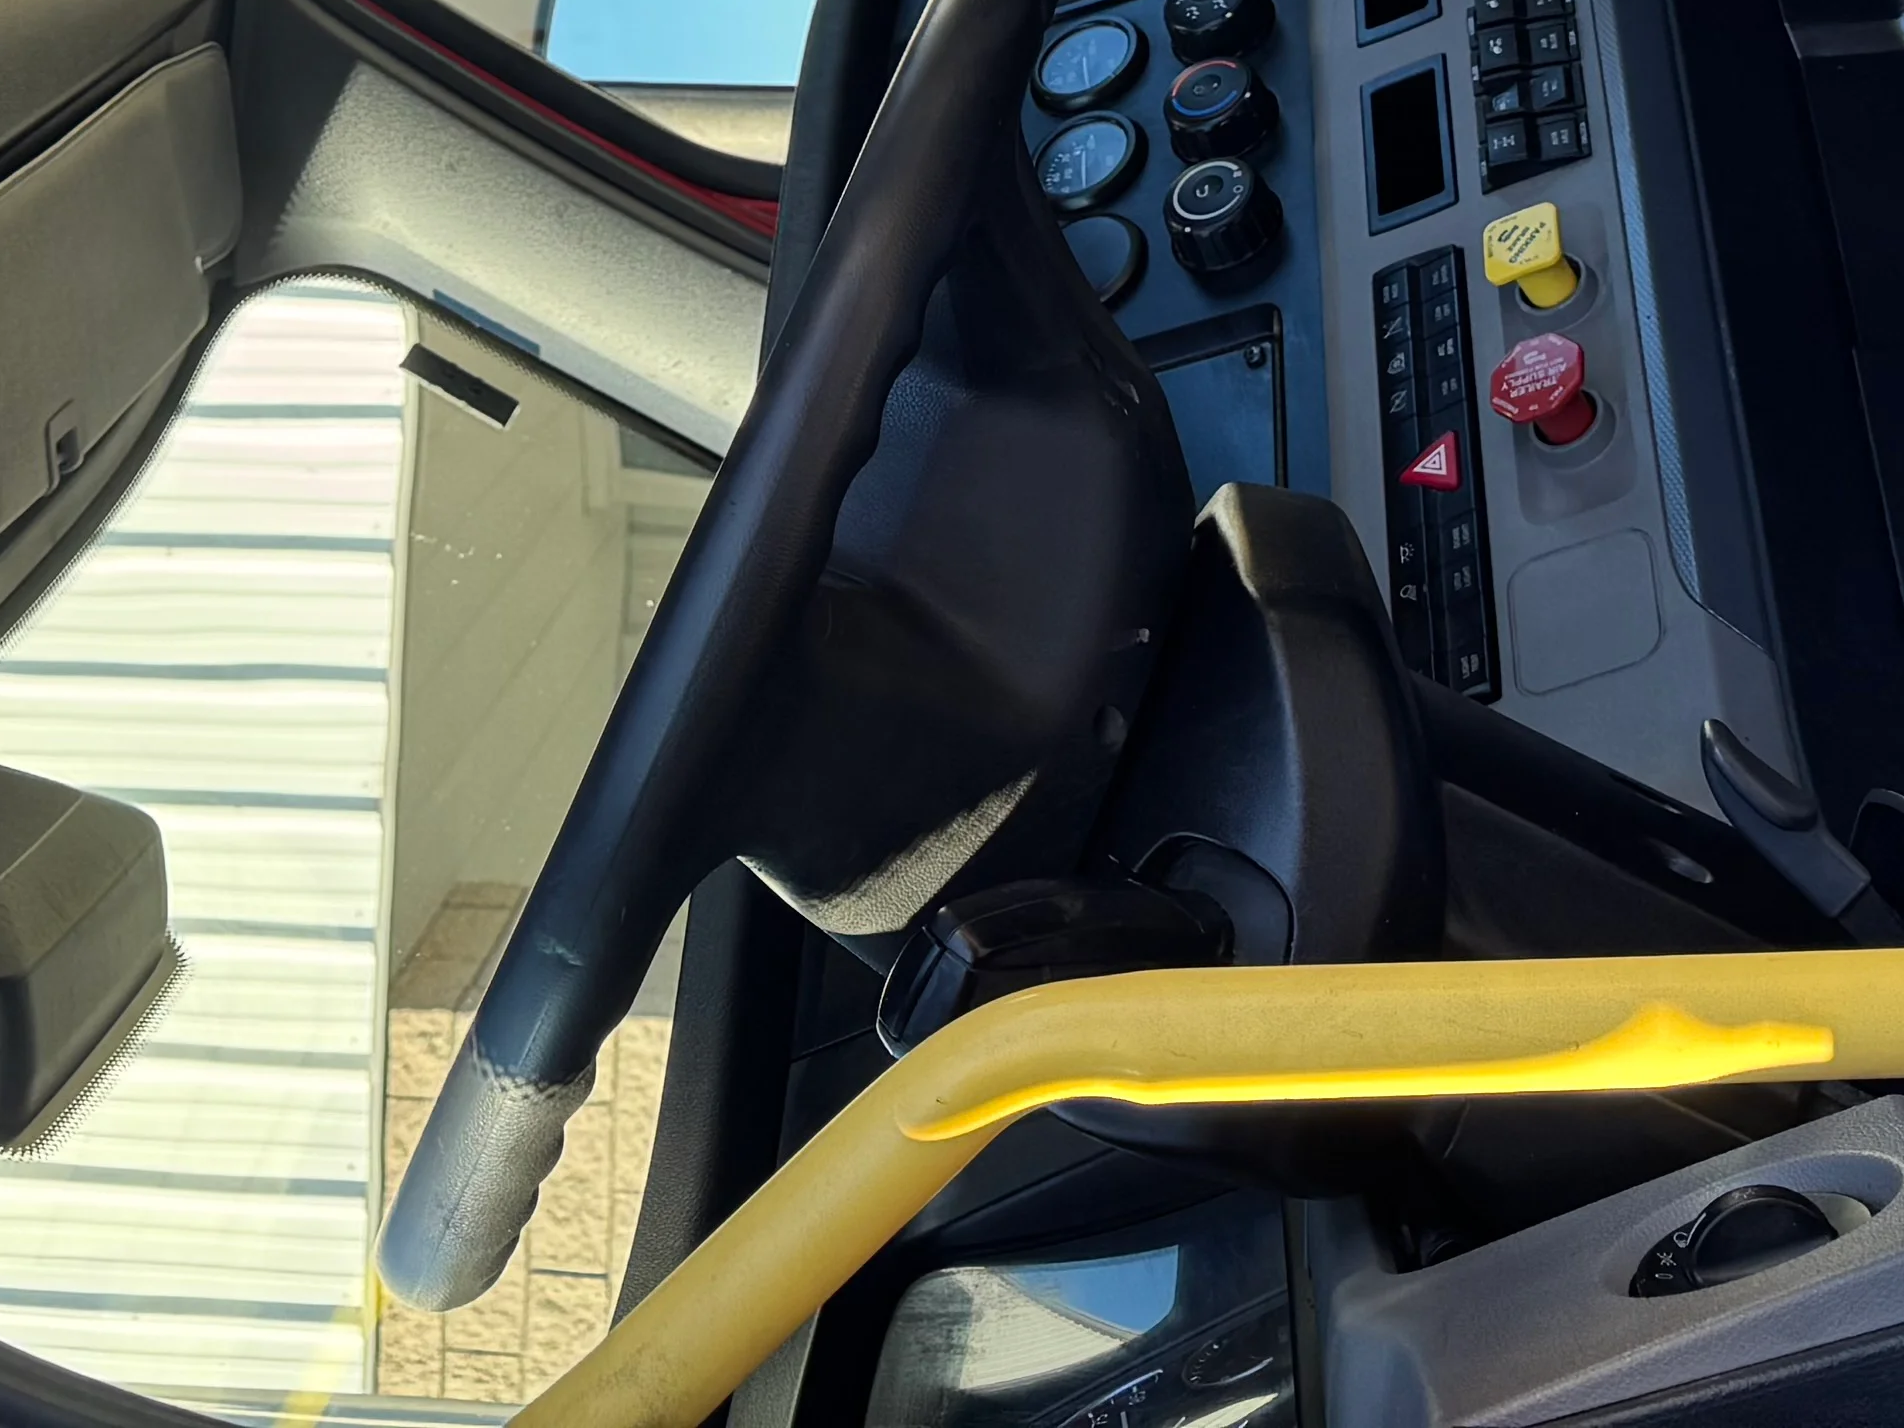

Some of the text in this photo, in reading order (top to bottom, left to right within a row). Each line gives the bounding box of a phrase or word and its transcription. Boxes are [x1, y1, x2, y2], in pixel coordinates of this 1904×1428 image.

[1509, 376, 1557, 398] TRAILER
[1461, 523, 1470, 545] LIGHT
[1463, 565, 1471, 587] LIGHT
[1460, 656, 1470, 679] LIGHT
[1471, 654, 1479, 672] TEST
